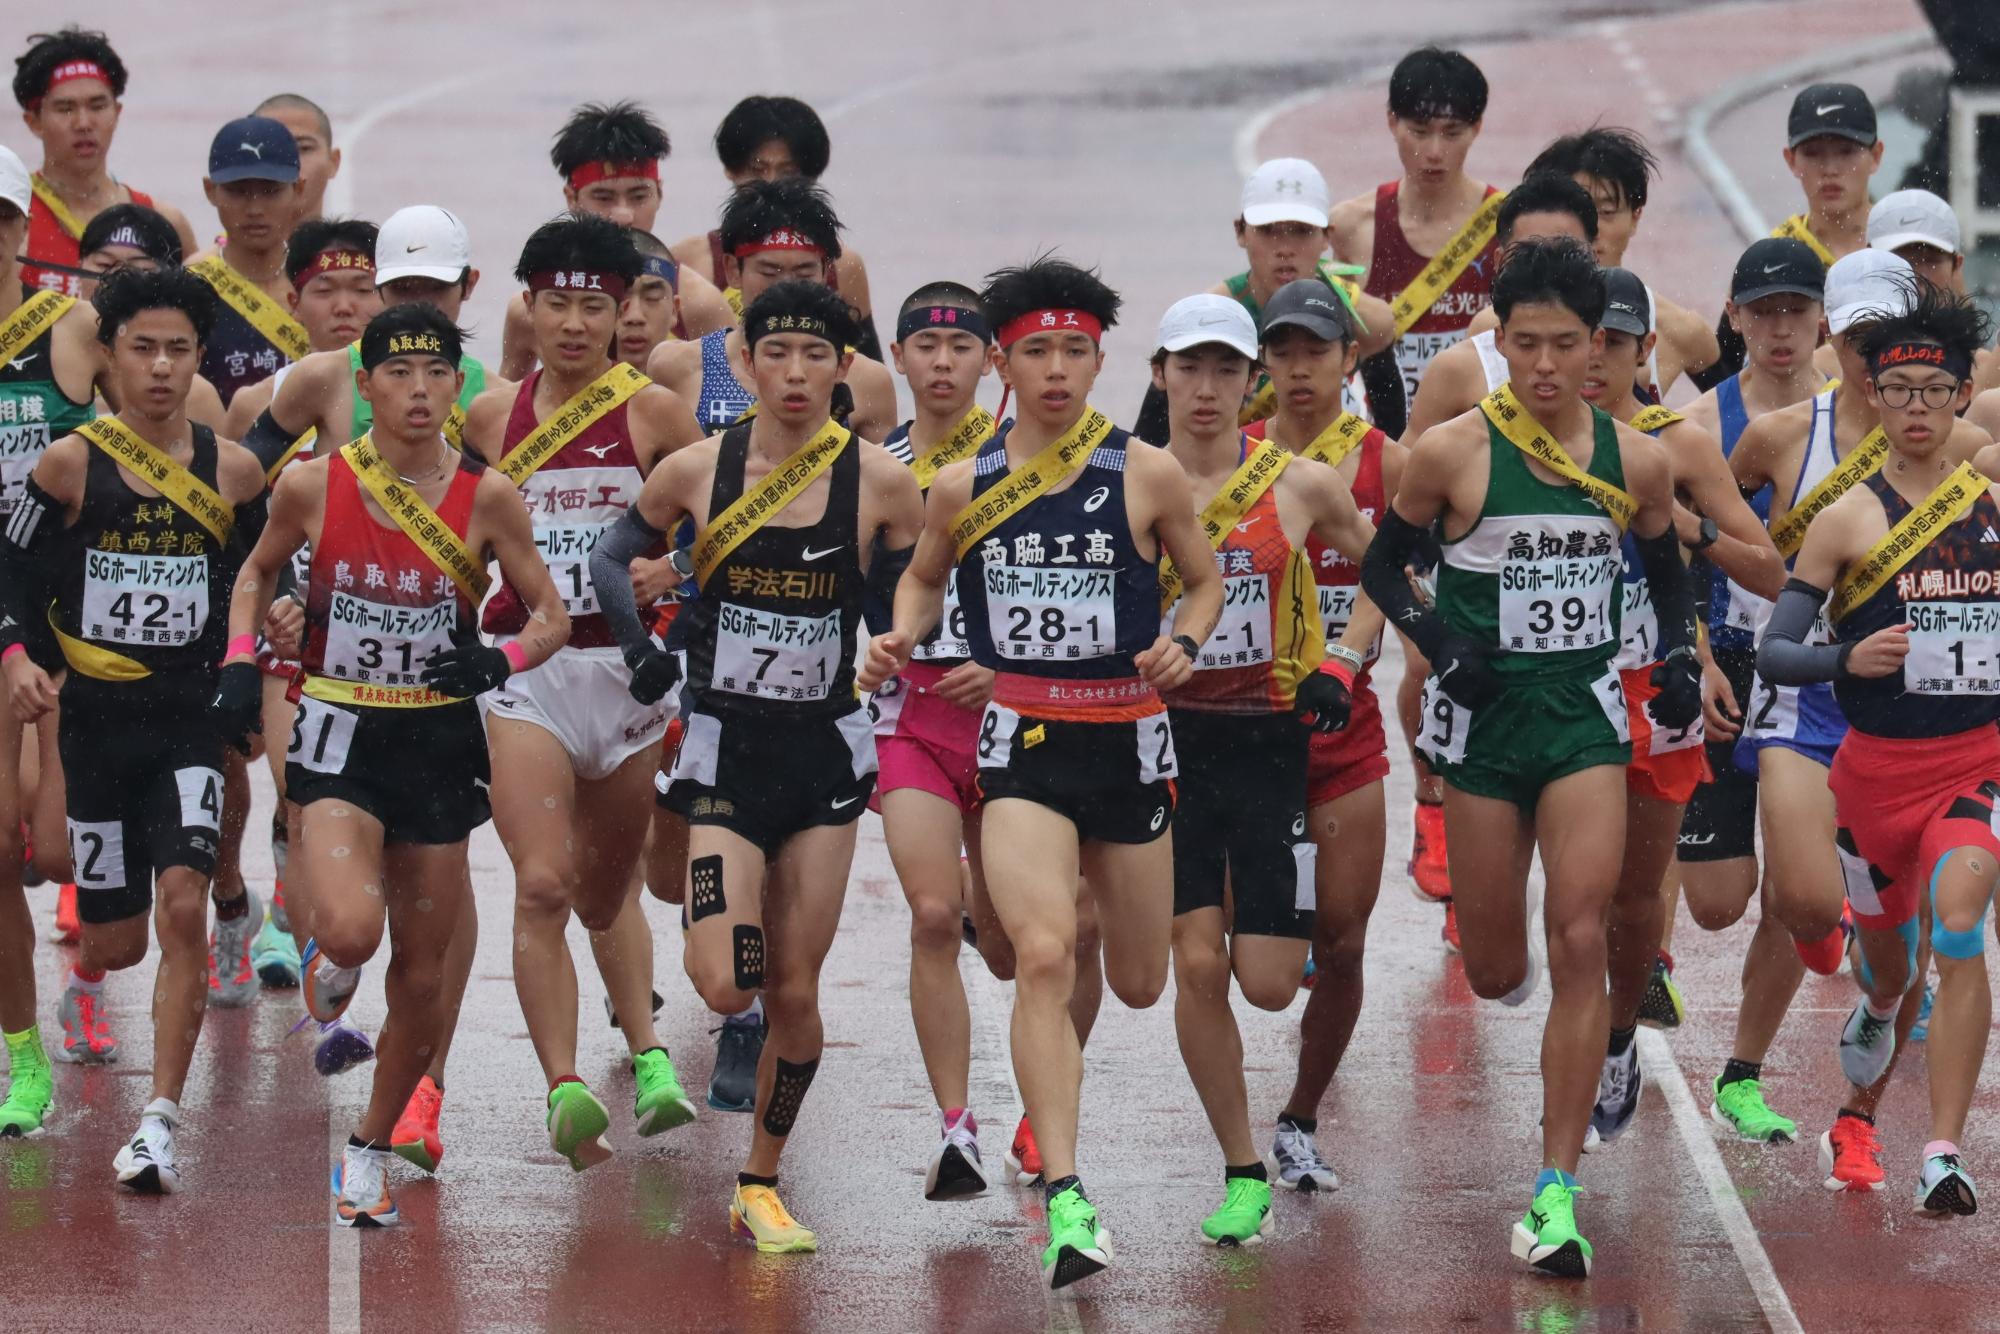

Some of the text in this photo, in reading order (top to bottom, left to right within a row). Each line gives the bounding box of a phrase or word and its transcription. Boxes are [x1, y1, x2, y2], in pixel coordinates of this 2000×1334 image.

[319, 252, 370, 270] 今治北
[554, 271, 602, 290] 鳥栖工
[1040, 312, 1079, 327] 西工
[389, 334, 441, 353] 鳥取城北
[133, 503, 176, 525] 長崎
[97, 530, 206, 556] 鎮西学院
[1507, 530, 1613, 562] 高知農高
[89, 554, 206, 588] SGホールディングス
[334, 559, 456, 598] 鳥取城北
[727, 565, 836, 600] 学法石川
[988, 567, 1112, 600] SGホールディングス
[1503, 557, 1619, 592] SGホールディングス
[109, 591, 197, 629] 42-1
[333, 595, 454, 635] SGホールディングス
[721, 606, 838, 647] SGホールディングス
[1008, 606, 1100, 643] 28-1
[1528, 596, 1605, 635] 39-1
[1909, 605, 2000, 634] SGホールディン
[752, 647, 826, 683] 7-1
[998, 640, 1105, 658] 兵庫・西脇工
[1049, 680, 1153, 700] 出してみせます高校
[1154, 721, 1173, 775] 2
[200, 774, 225, 823] 4
[69, 825, 107, 882] 2
